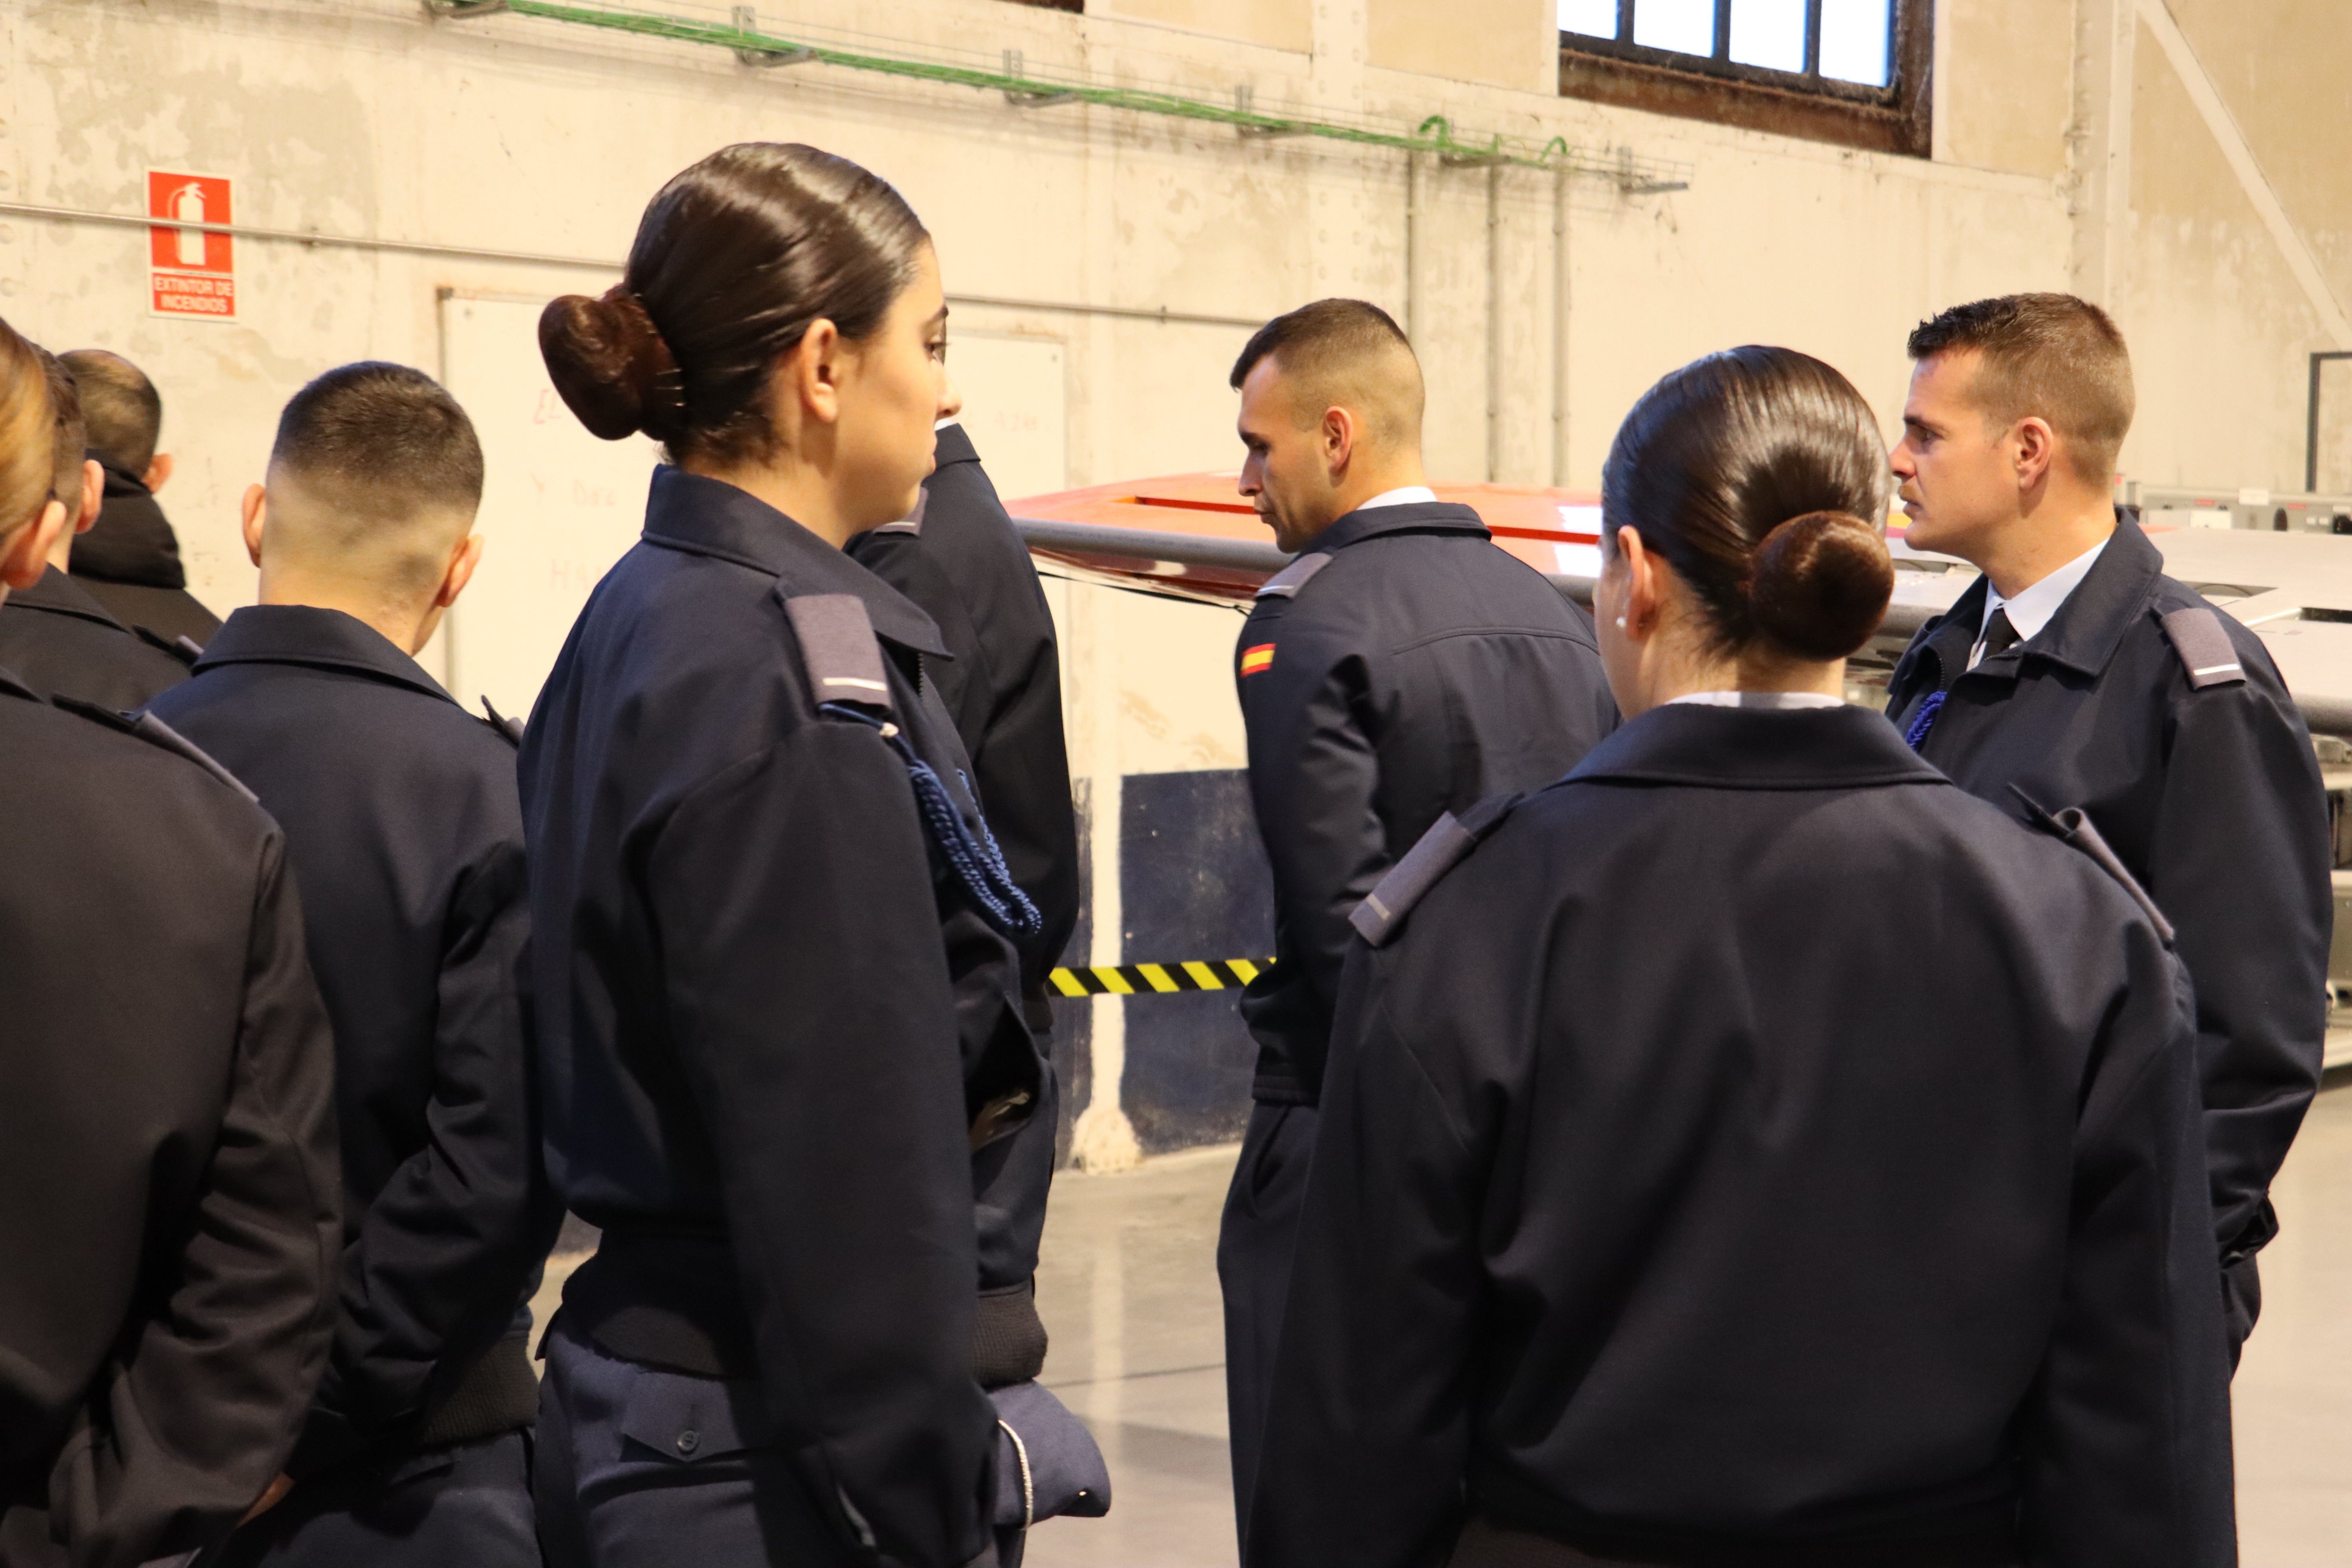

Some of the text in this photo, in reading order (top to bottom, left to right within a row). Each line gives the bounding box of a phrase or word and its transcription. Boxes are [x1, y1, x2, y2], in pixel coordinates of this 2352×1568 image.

[155, 277, 233, 296] EXTINTOR DE
[161, 294, 227, 312] INCENDIOS
